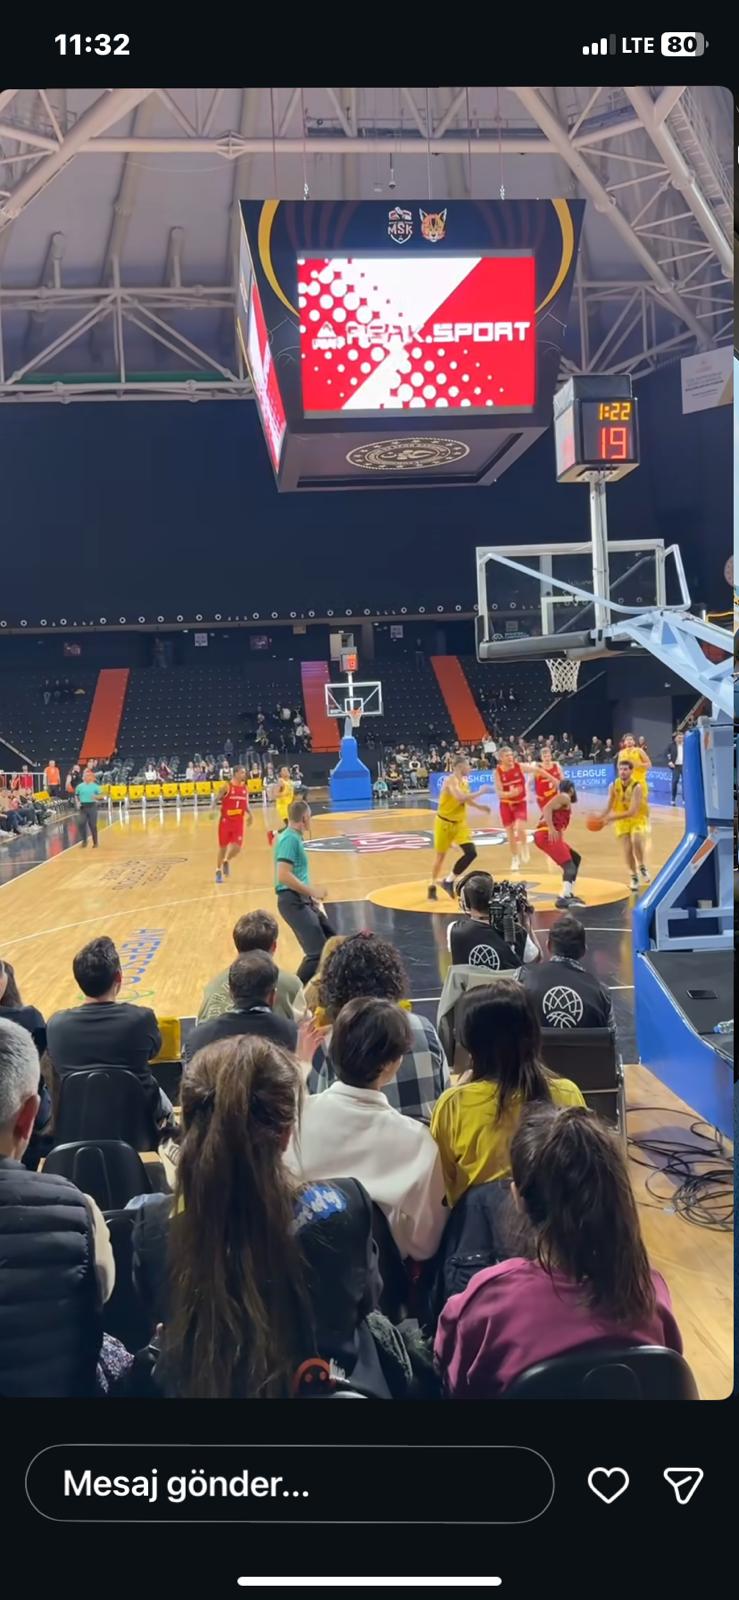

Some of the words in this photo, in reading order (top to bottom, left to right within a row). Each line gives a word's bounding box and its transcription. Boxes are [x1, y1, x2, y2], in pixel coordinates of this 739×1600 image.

[388, 221, 412, 235] MSK
[598, 402, 632, 421] 1:22
[601, 427, 627, 459] 19
[571, 768, 608, 778] LEAGUE
